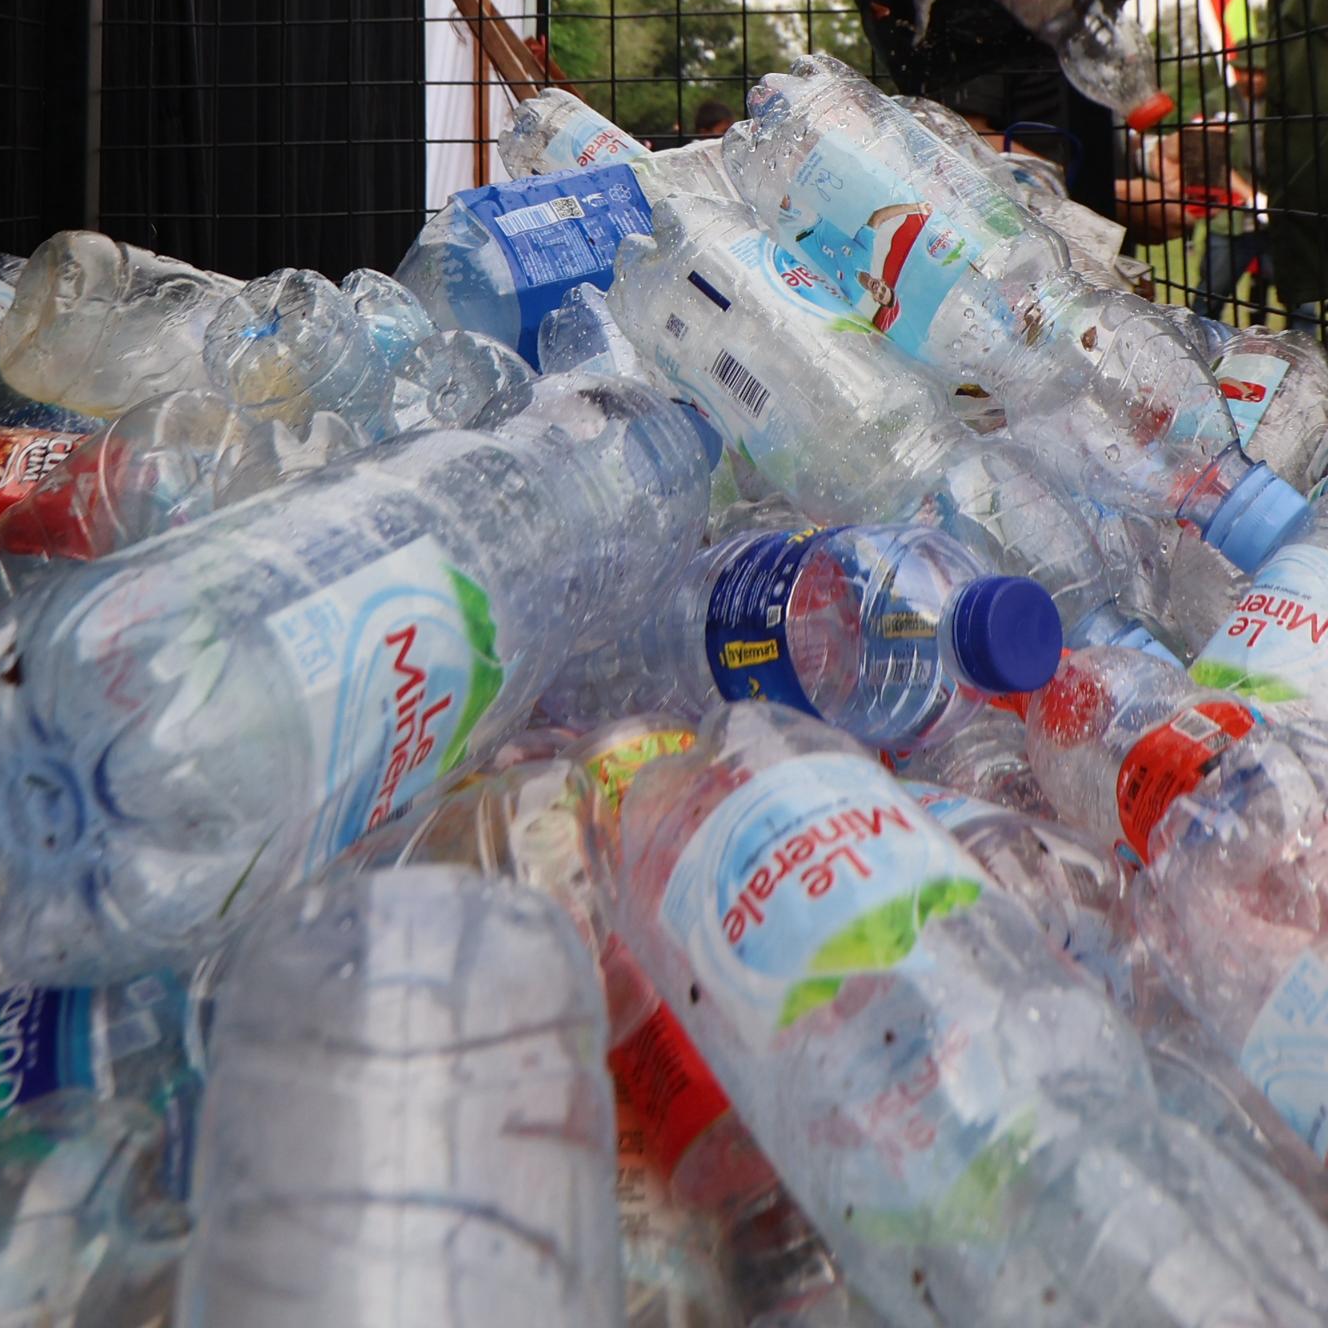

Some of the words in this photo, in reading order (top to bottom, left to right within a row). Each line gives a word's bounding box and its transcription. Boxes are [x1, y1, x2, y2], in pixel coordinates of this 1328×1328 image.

[606, 138, 629, 155] Le
[1227, 616, 1268, 648] Le
[405, 691, 453, 772] Le
[721, 803, 916, 946] Minerale
[802, 837, 873, 901] Le
